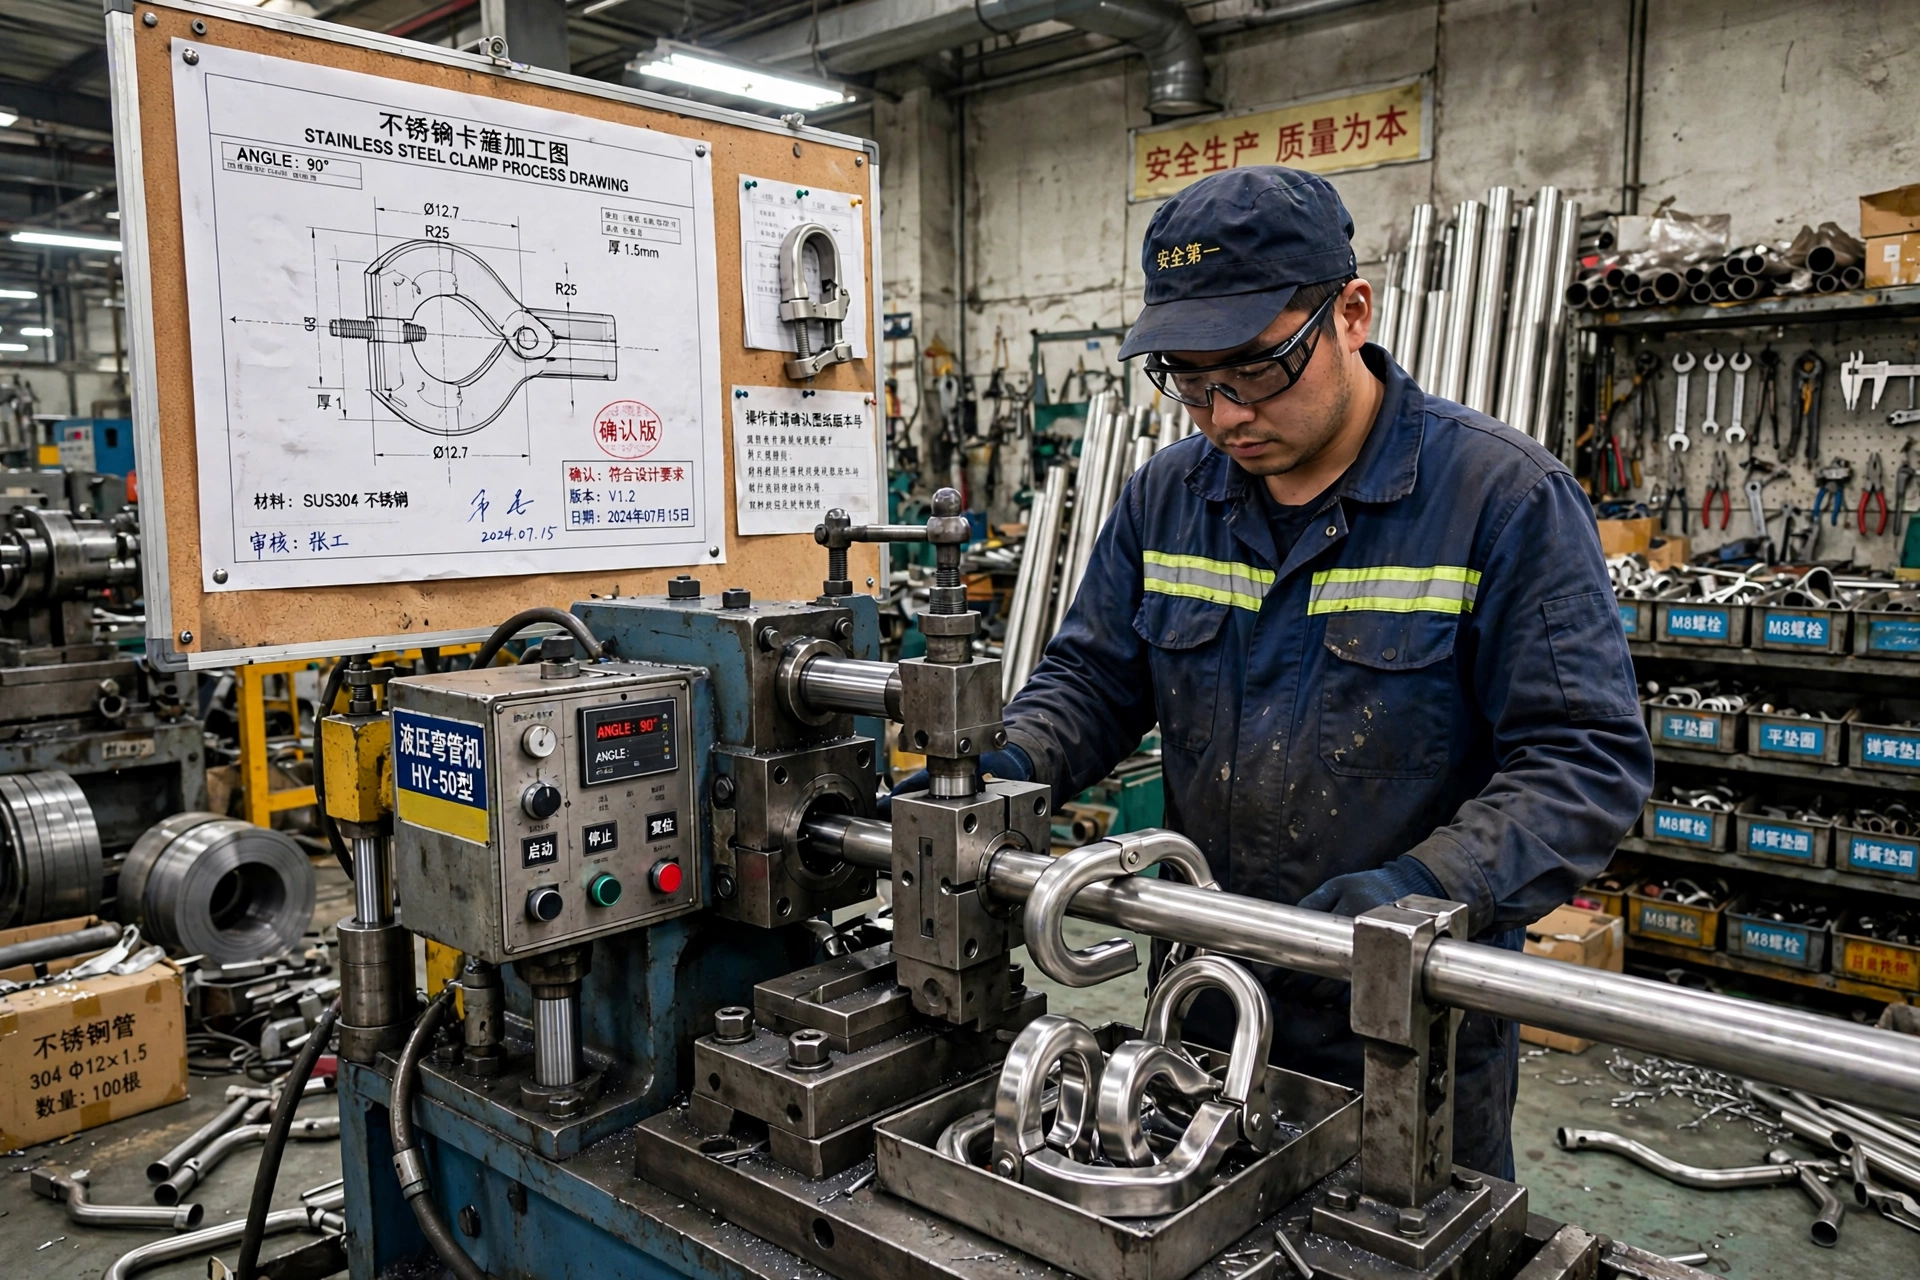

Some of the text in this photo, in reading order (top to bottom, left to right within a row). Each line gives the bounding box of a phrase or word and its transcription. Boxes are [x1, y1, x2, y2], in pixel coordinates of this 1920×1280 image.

[1146, 104, 1408, 182] 安全生产 质量为本
[237, 147, 299, 169] ANGLE:
[307, 158, 329, 172] 90°
[304, 127, 629, 193] STAINLESS STEEL CLAMP PROCESS DRAWING
[425, 225, 449, 239] R25
[624, 244, 660, 259] 1.5mm
[1157, 242, 1220, 271] 安全第一
[555, 283, 577, 296] R25
[599, 418, 657, 442] 确认版
[609, 466, 684, 483] 符合设计要求
[303, 493, 358, 507] SUS304
[608, 490, 635, 502] V1.2
[608, 508, 689, 524] 2024年07月15日
[309, 531, 349, 552] 张工
[481, 526, 557, 542] 2024.07.15
[1671, 615, 1722, 633] M8螺栓
[1768, 620, 1823, 640] M8螺栓
[597, 717, 658, 739] ANGLE: 90°
[399, 722, 482, 770] 液压弯管机
[595, 748, 629, 763] ANGLE:
[411, 762, 474, 802] HY-50型
[651, 818, 674, 835] 复位
[1659, 815, 1707, 836] M8螺栓
[588, 828, 612, 846] 停止
[528, 842, 553, 860] 启动
[1746, 930, 1800, 954] M8螺栓
[33, 1013, 136, 1060] 不锈钢管
[30, 1065, 62, 1090] 304
[93, 1071, 142, 1101] 100根
